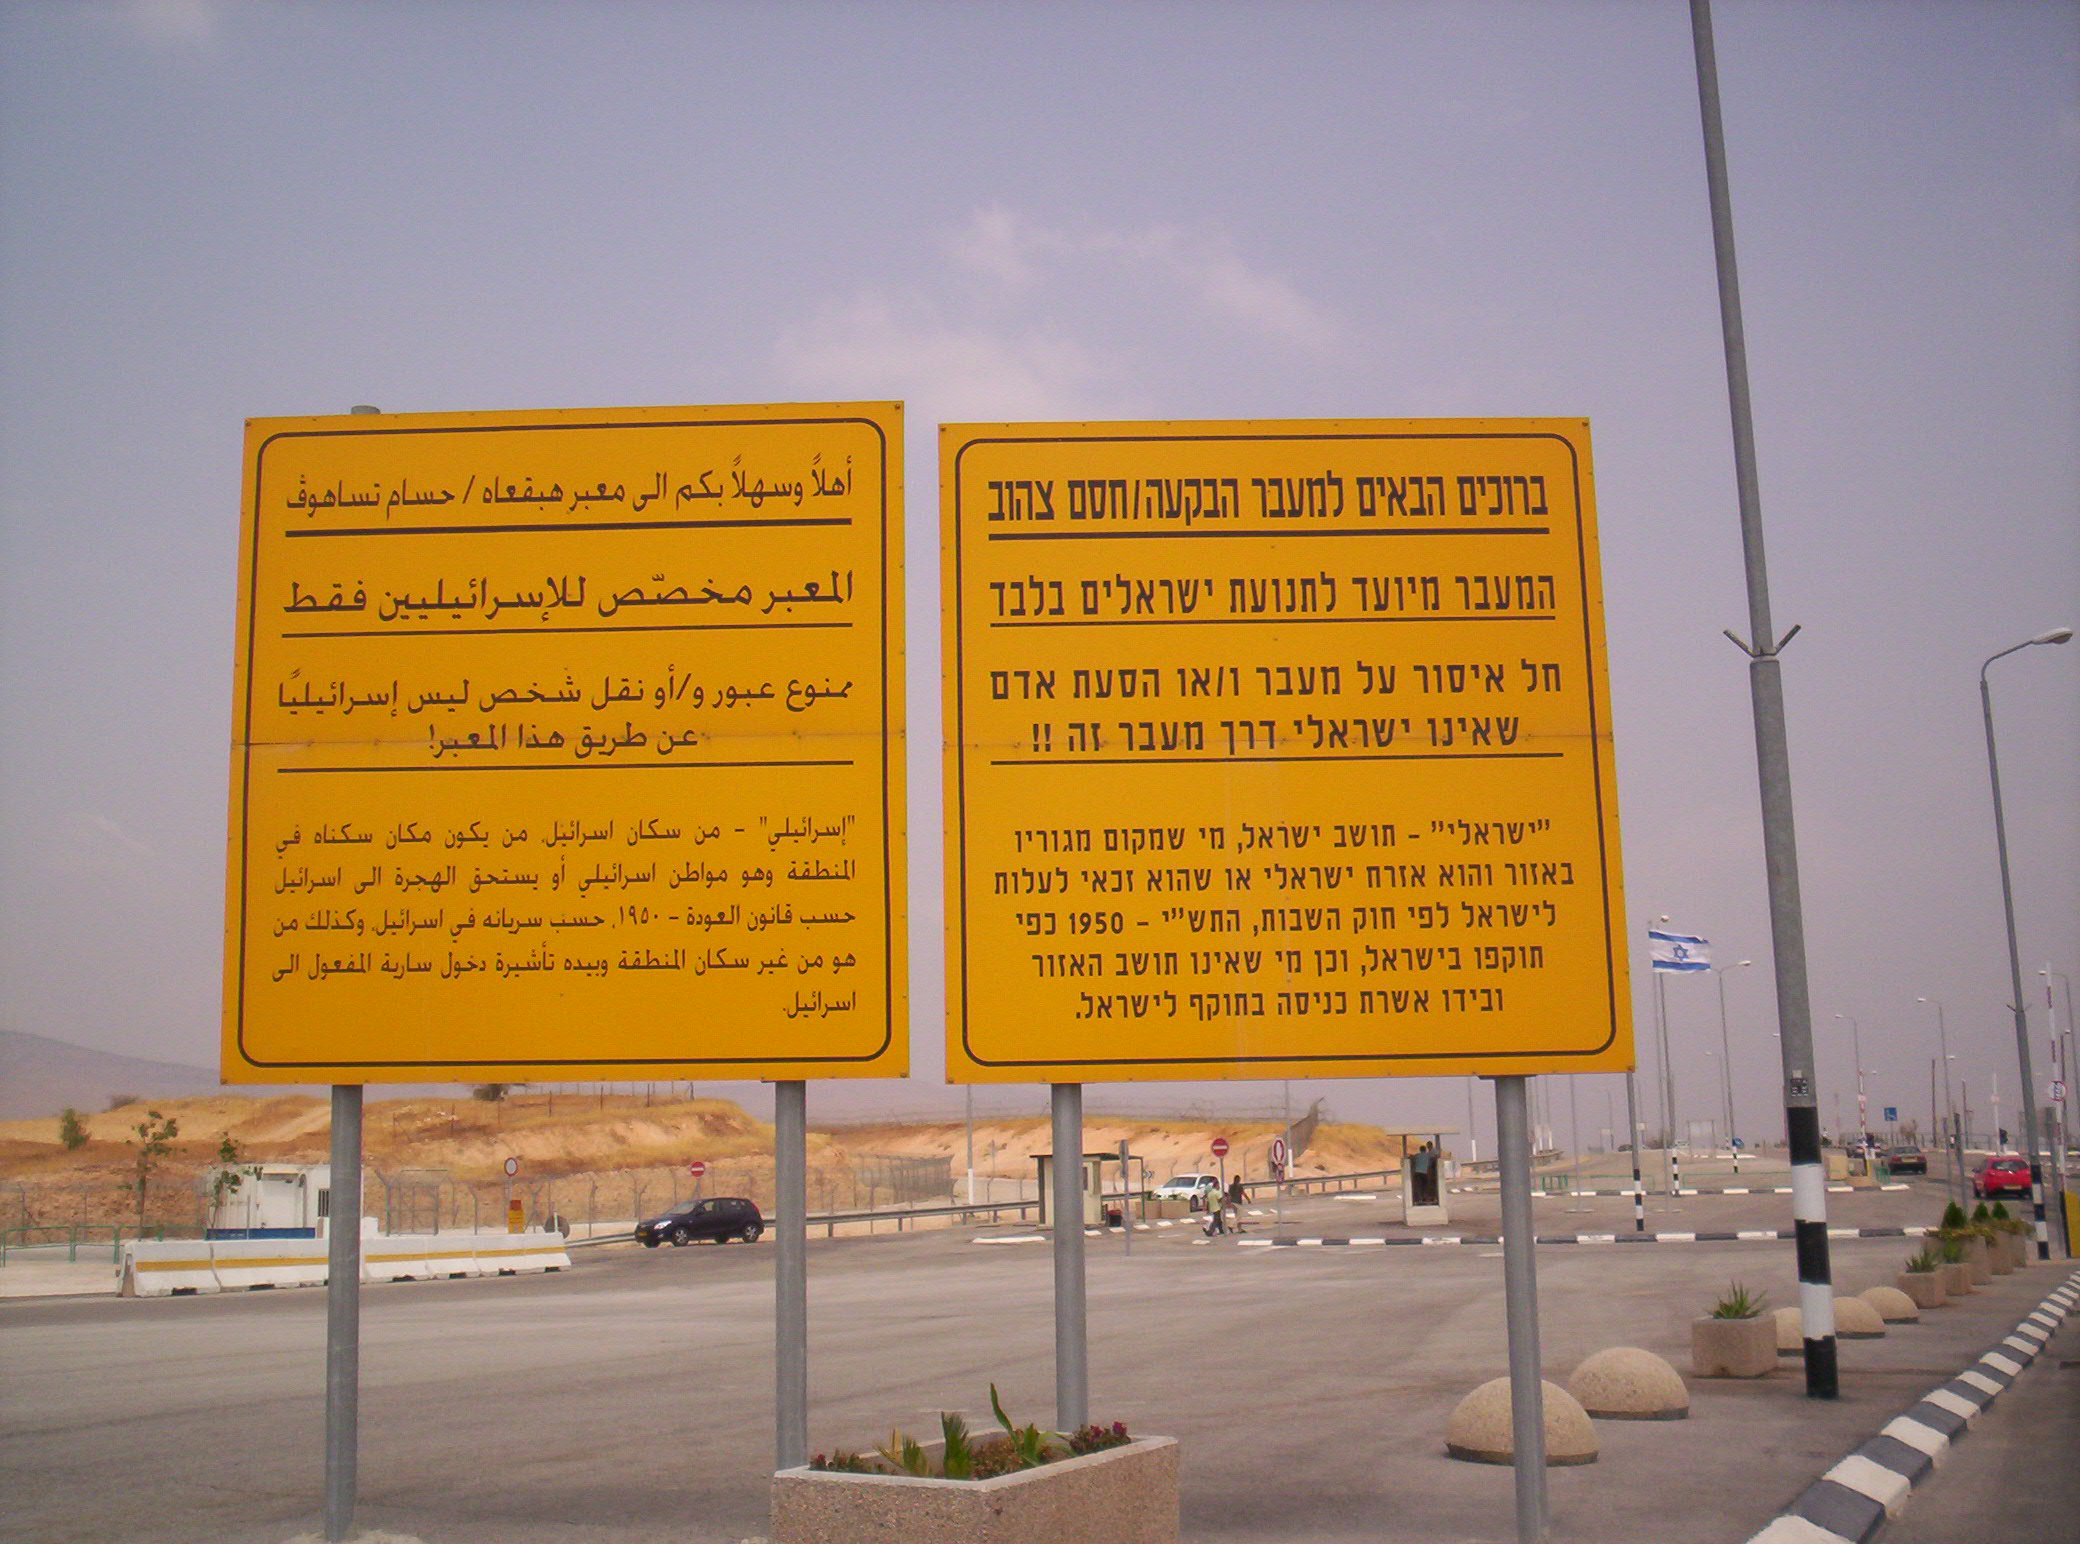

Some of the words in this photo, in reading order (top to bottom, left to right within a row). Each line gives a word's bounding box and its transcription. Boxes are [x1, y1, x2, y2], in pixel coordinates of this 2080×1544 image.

[386, 479, 455, 520] حسام
[462, 475, 475, 504] /
[569, 483, 625, 512] معبر
[676, 470, 723, 510] بكم
[988, 481, 1054, 521] צהוב
[1068, 478, 1239, 526] הבקעה/חסם
[1251, 470, 1343, 518] למעבר
[1356, 476, 1445, 516] הבאים
[1456, 476, 1548, 515] ברוכים
[283, 580, 367, 612] فقط
[378, 576, 586, 622] للإسرائيليين
[761, 570, 852, 614] المعبر
[990, 575, 1064, 616] בלבד
[1081, 574, 1213, 615] ישראלים
[1229, 571, 1336, 613] לתנועת
[1352, 576, 1439, 611] מיועד
[1455, 575, 1555, 610] המעבר
[990, 671, 1055, 700] אדם
[1073, 669, 1159, 698] הסעת
[1177, 667, 1239, 697] ו/או
[1256, 667, 1340, 695] מעבר
[1357, 661, 1395, 694] על
[1413, 664, 1504, 693] איסור
[1521, 658, 1561, 692] חל
[408, 679, 469, 714] ليس
[479, 675, 581, 712] شخص
[591, 676, 644, 711] نقل
[712, 683, 775, 708] عبور
[786, 678, 853, 712] ممنوع
[519, 724, 564, 748] هذا
[575, 721, 647, 759] طريق
[657, 730, 697, 755] عن
[1068, 723, 1104, 752] זה
[1119, 721, 1203, 751] מעבר
[1220, 721, 1275, 755] דרך
[1293, 714, 1410, 749] ישראלי
[1427, 717, 1518, 746] שאינו
[276, 825, 300, 859] في
[314, 824, 372, 844] سكناه
[386, 822, 431, 850] مكان
[445, 821, 488, 849] يكون
[502, 829, 527, 848] من
[627, 819, 680, 846] سكان
[695, 826, 720, 845] من
[1015, 830, 1090, 853] מגוריו
[1104, 828, 1185, 855] שמקום
[1199, 827, 1224, 849] מי
[1238, 823, 1320, 854] ישראל,
[1334, 825, 1395, 848] תושב
[275, 867, 341, 894] اسرائيل
[395, 865, 455, 893] الهجرة
[469, 868, 538, 893] يستحق
[552, 855, 564, 891] أو
[579, 863, 655, 898] اسرائيلي
[669, 862, 727, 889] مواطن
[742, 868, 773, 888] وهو
[787, 859, 855, 880] المنطقة
[995, 867, 1068, 894] לעלות
[1081, 870, 1133, 893] זכאי
[1147, 869, 1211, 892] שהוא
[1225, 868, 1251, 890] או
[1264, 864, 1353, 890] ישראלי
[1366, 865, 1425, 888] אזרח
[1439, 864, 1492, 887] והוא
[1505, 863, 1574, 885] באזור
[274, 919, 298, 937] من
[305, 909, 364, 936] وكذلك
[450, 907, 475, 943] في
[483, 908, 542, 934] سريانه
[550, 916, 605, 933] حسب
[687, 905, 740, 932] العودة
[747, 904, 792, 931] قانون
[800, 912, 856, 930] حسب
[1015, 913, 1056, 935] כפי
[1069, 912, 1123, 934] 1950
[1253, 908, 1340, 937] השבות,
[1353, 907, 1395, 934] חוק
[1408, 902, 1449, 928] לפי
[1461, 900, 1555, 928] לישראל
[308, 953, 371, 980] المفعول
[381, 952, 432, 980] سارية
[441, 952, 486, 979] دخول
[496, 941, 554, 978] تأشيرة
[564, 959, 608, 977] وبيده
[618, 949, 685, 970] المنطقة
[695, 948, 749, 976] سكان
[757, 948, 788, 976] غير
[798, 955, 823, 975] من
[833, 954, 856, 974] هو
[1032, 954, 1102, 977] האזור
[1116, 953, 1177, 976] תושב
[1190, 951, 1261, 975] שאינו
[1275, 951, 1301, 973] מי
[1314, 950, 1348, 977] וכן
[1361, 945, 1461, 977] בישראל,
[1474, 946, 1543, 973] תוקפו
[783, 991, 855, 1019] اسرائيل.
[1076, 990, 1176, 1019] לישראל.
[1190, 993, 1265, 1021] בתוקף
[1278, 992, 1347, 1015] כניסה
[1360, 990, 1429, 1014] אשרת
[1442, 989, 1503, 1012] ובידו
